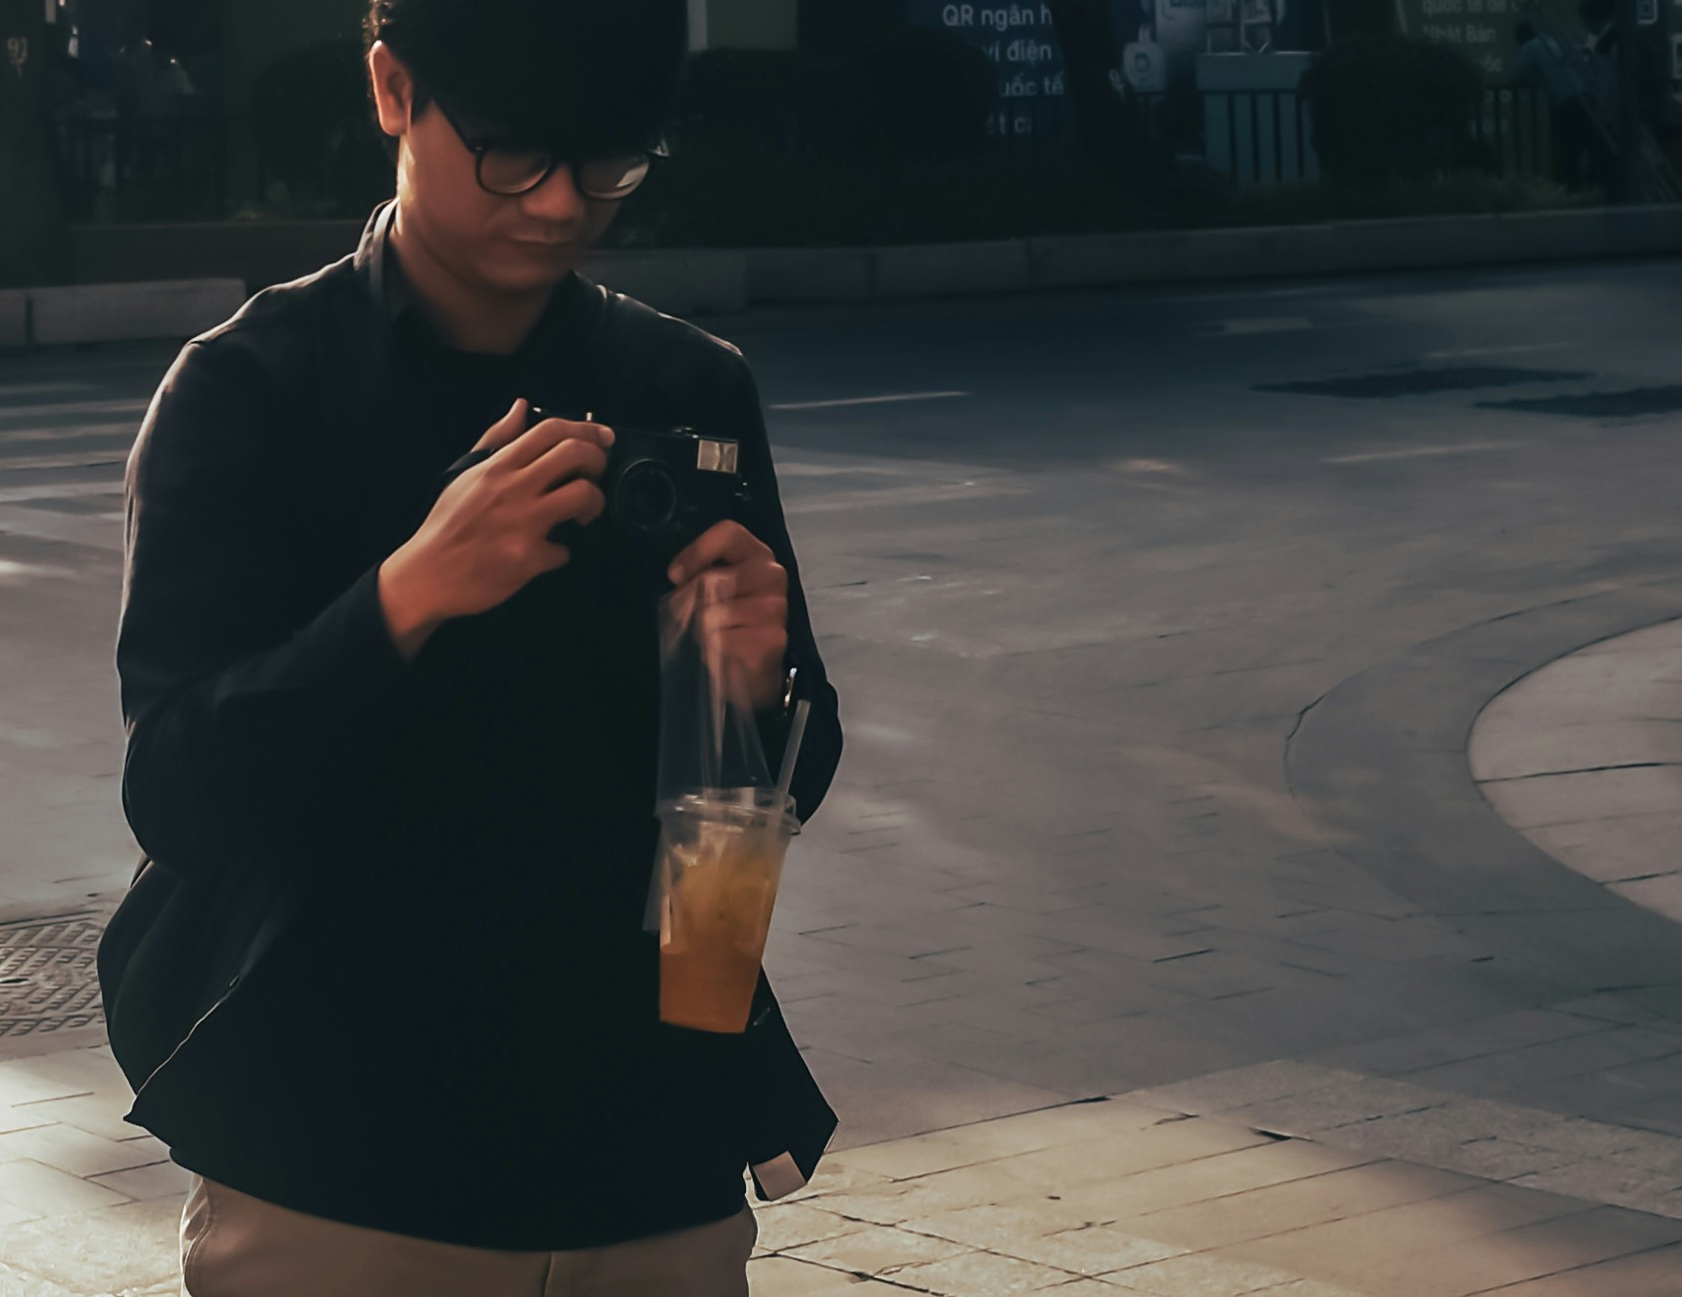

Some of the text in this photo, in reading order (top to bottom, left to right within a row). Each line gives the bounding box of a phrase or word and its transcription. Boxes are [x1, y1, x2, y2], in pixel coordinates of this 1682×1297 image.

[942, 4, 974, 26] QR
[980, 3, 1034, 31] ngân
[1006, 39, 1052, 65] điện
[998, 72, 1037, 97] uốc
